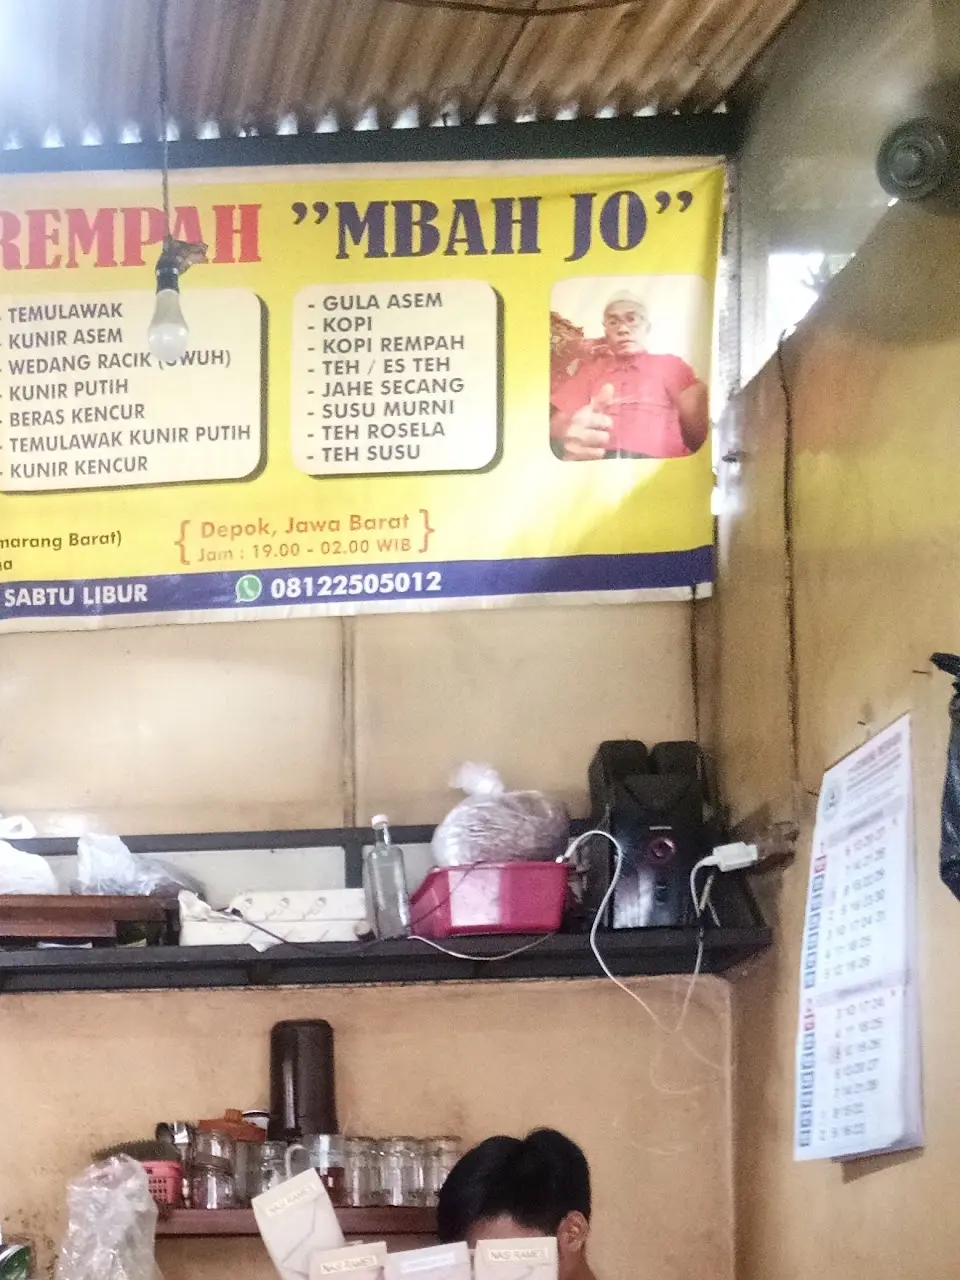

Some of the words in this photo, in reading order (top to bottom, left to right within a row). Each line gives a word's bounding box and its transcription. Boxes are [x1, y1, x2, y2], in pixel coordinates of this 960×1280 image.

[323, 295, 381, 310] GULA
[387, 293, 443, 309] ASEM
[8, 303, 123, 323] TEMULAWAK
[323, 317, 373, 333] KOPI
[9, 332, 68, 349] KUNIR
[73, 328, 123, 345] ASEM
[323, 339, 373, 355] KOPI
[380, 335, 465, 352] REMPAH
[8, 355, 91, 375] WEDANG
[97, 353, 152, 370] RACIK
[323, 360, 363, 375] TEH
[383, 358, 408, 374] ES
[413, 357, 451, 373] TEH
[9, 383, 68, 401] KUNIR
[74, 379, 129, 396] PUTIH
[322, 380, 374, 397] JAHE
[380, 378, 465, 394] SECANG
[10, 409, 65, 428] BERAS
[71, 405, 145, 423] KENCUR
[322, 401, 375, 418] SUSU
[381, 400, 454, 416] MURNI
[10, 433, 123, 453] TEMULAWAK
[129, 429, 189, 445] KUNIR
[195, 426, 251, 442] PUTIH
[322, 424, 359, 440] TEH
[367, 422, 445, 438] ROSELA
[322, 446, 361, 462] TEH
[366, 445, 421, 461] SUSU
[11, 460, 69, 478] KUNIR
[74, 456, 148, 475] KENCUR
[201, 519, 277, 541] Depok,
[285, 516, 342, 535] Jawa
[348, 513, 409, 532] Barat
[69, 530, 123, 549] Barat)
[197, 546, 235, 563] Jam
[252, 541, 301, 558] 19.00
[320, 539, 370, 556] 02.00
[376, 537, 412, 554] WIB
[4, 588, 74, 607] SABTU
[83, 584, 148, 603] LIBUR
[270, 573, 441, 599] 08122505012
